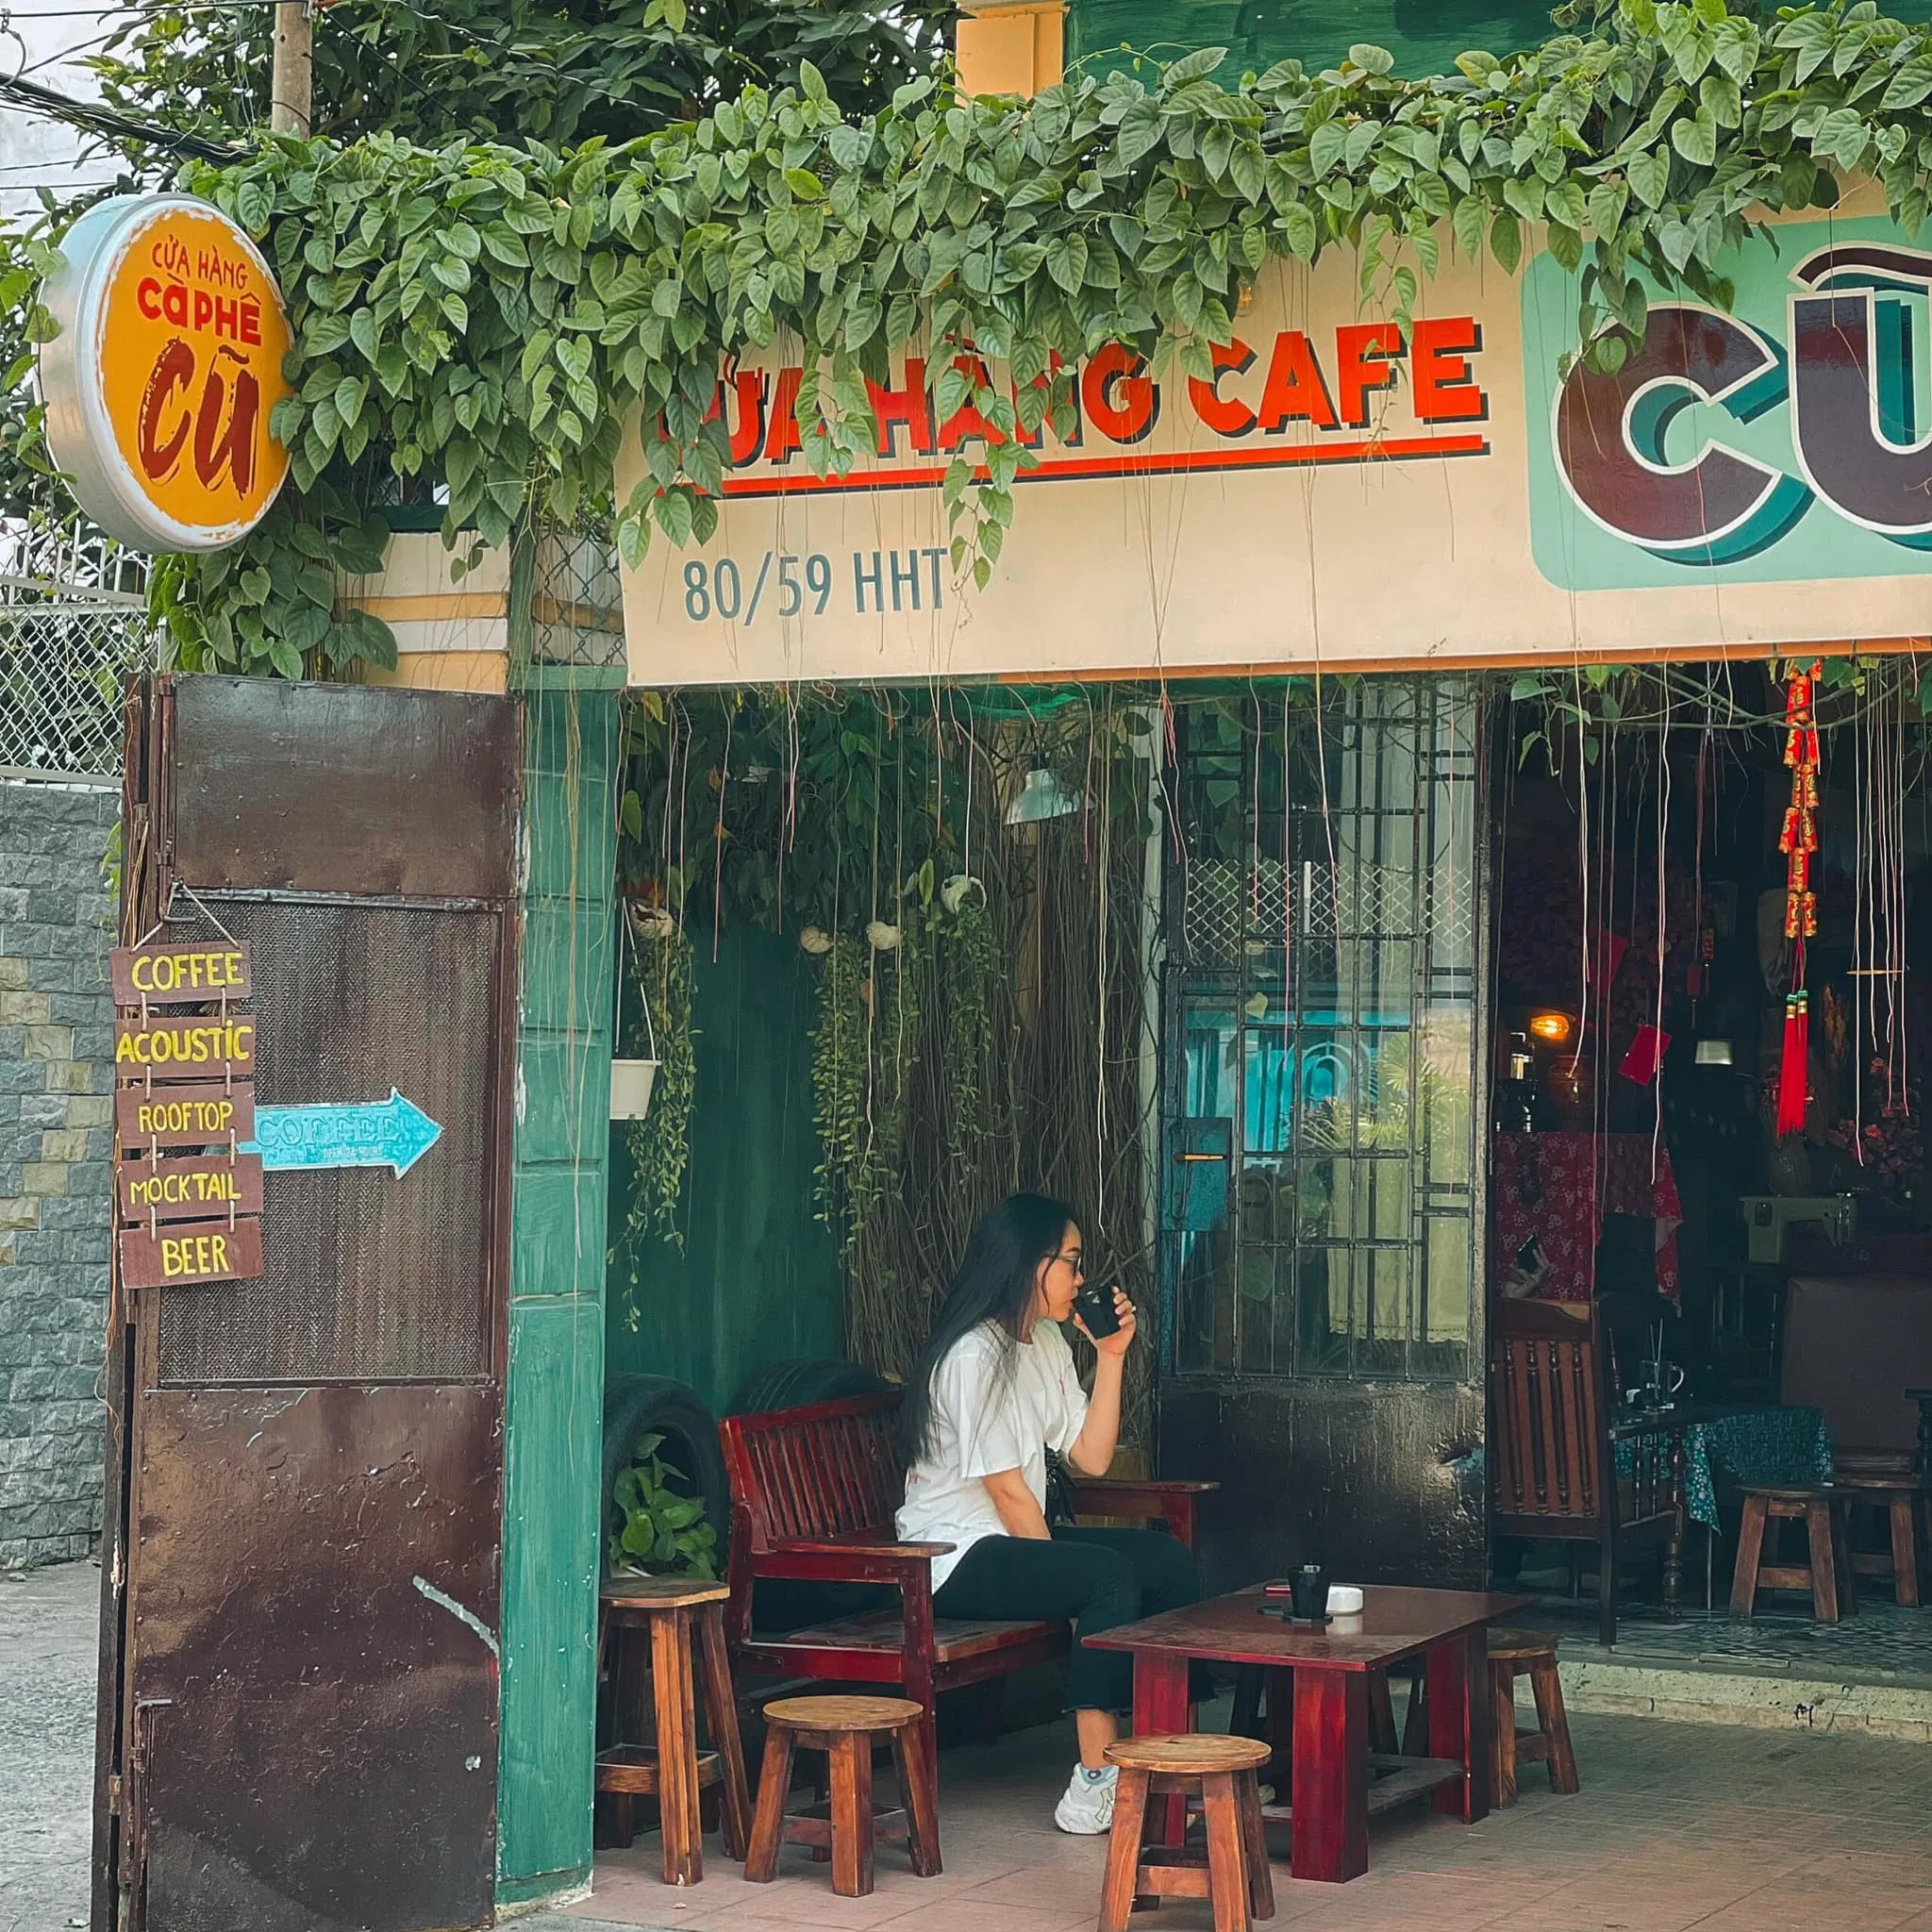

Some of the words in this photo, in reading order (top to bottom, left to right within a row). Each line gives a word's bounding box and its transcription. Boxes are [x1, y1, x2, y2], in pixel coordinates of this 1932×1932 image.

[152, 233, 191, 278] CỬA
[198, 244, 248, 290] HÀNG
[1187, 316, 1490, 439] CAFE
[682, 551, 832, 626] 80/59
[853, 547, 948, 614] HHT
[131, 952, 244, 991] COFFEE
[139, 1100, 234, 1133] ROOFTOP
[257, 1116, 401, 1148] COFFEE
[130, 1173, 242, 1206] MOCKTAIL
[160, 1234, 231, 1277] BEER
